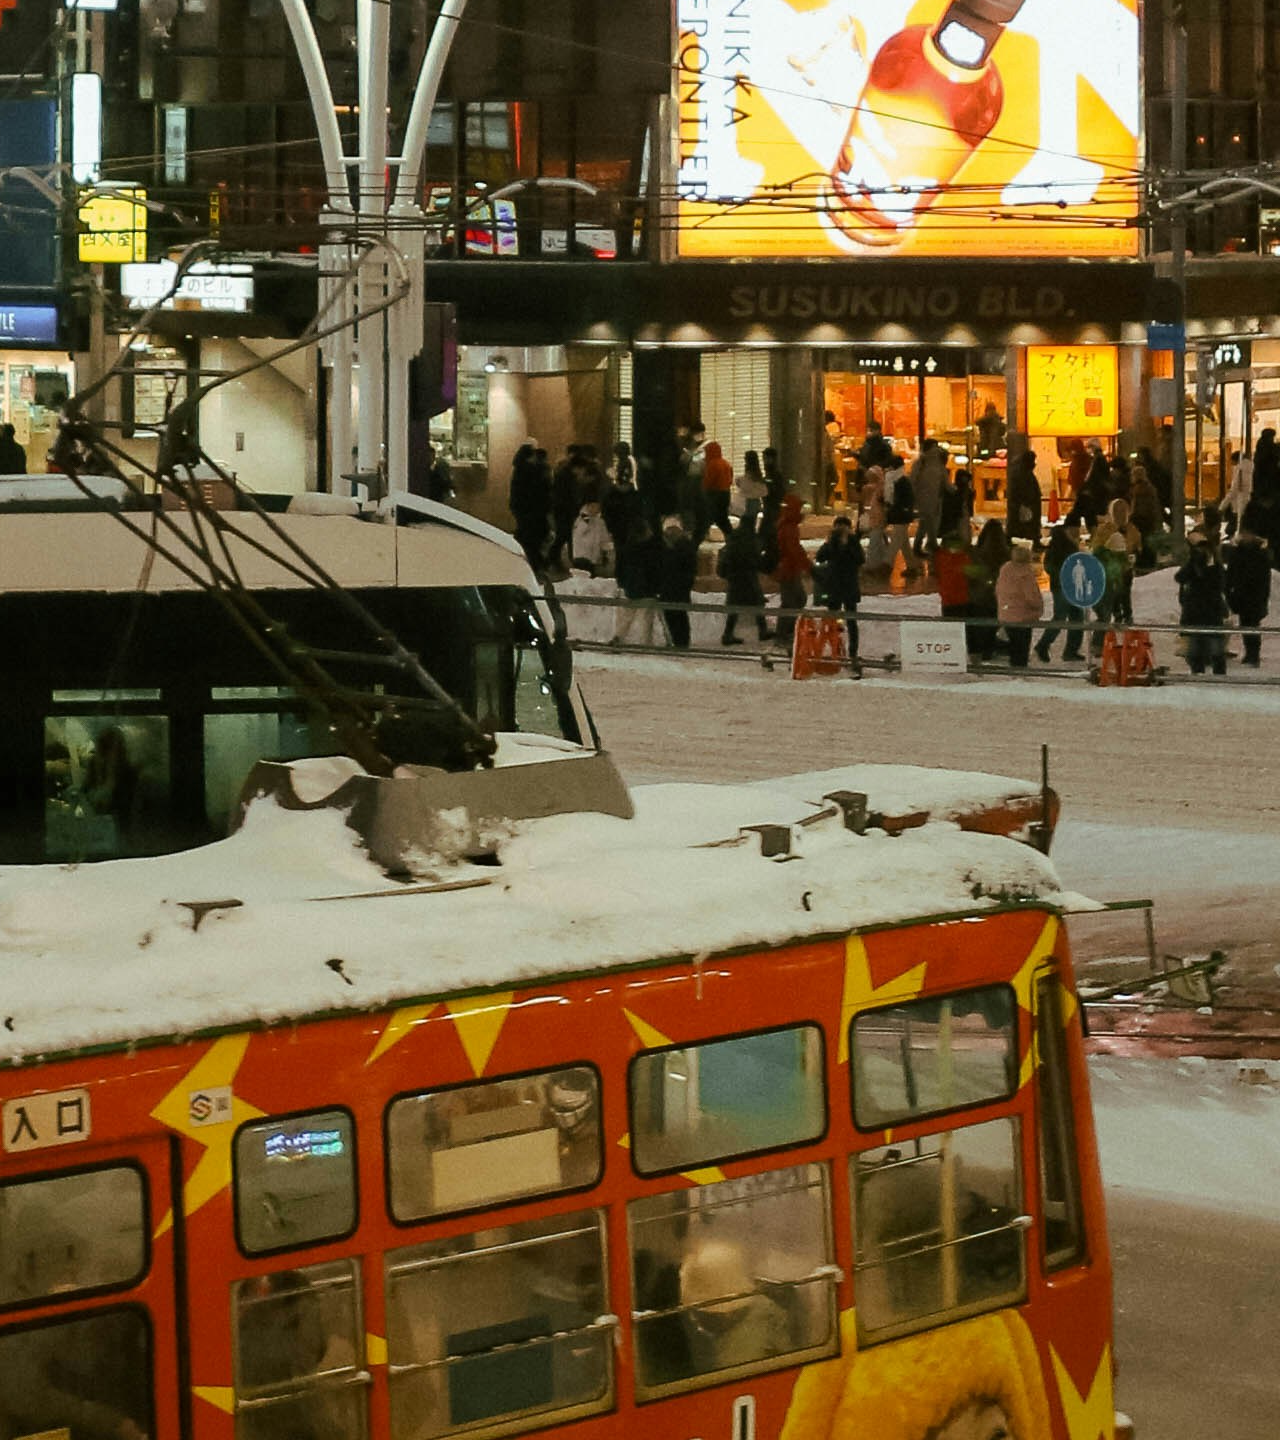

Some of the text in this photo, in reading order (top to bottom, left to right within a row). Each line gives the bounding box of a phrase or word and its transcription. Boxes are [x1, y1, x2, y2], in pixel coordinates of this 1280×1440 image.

[730, 285, 1075, 318] SUSUKINO BLD.
[915, 642, 951, 656] STOP
[9, 1099, 86, 1145] 入口
